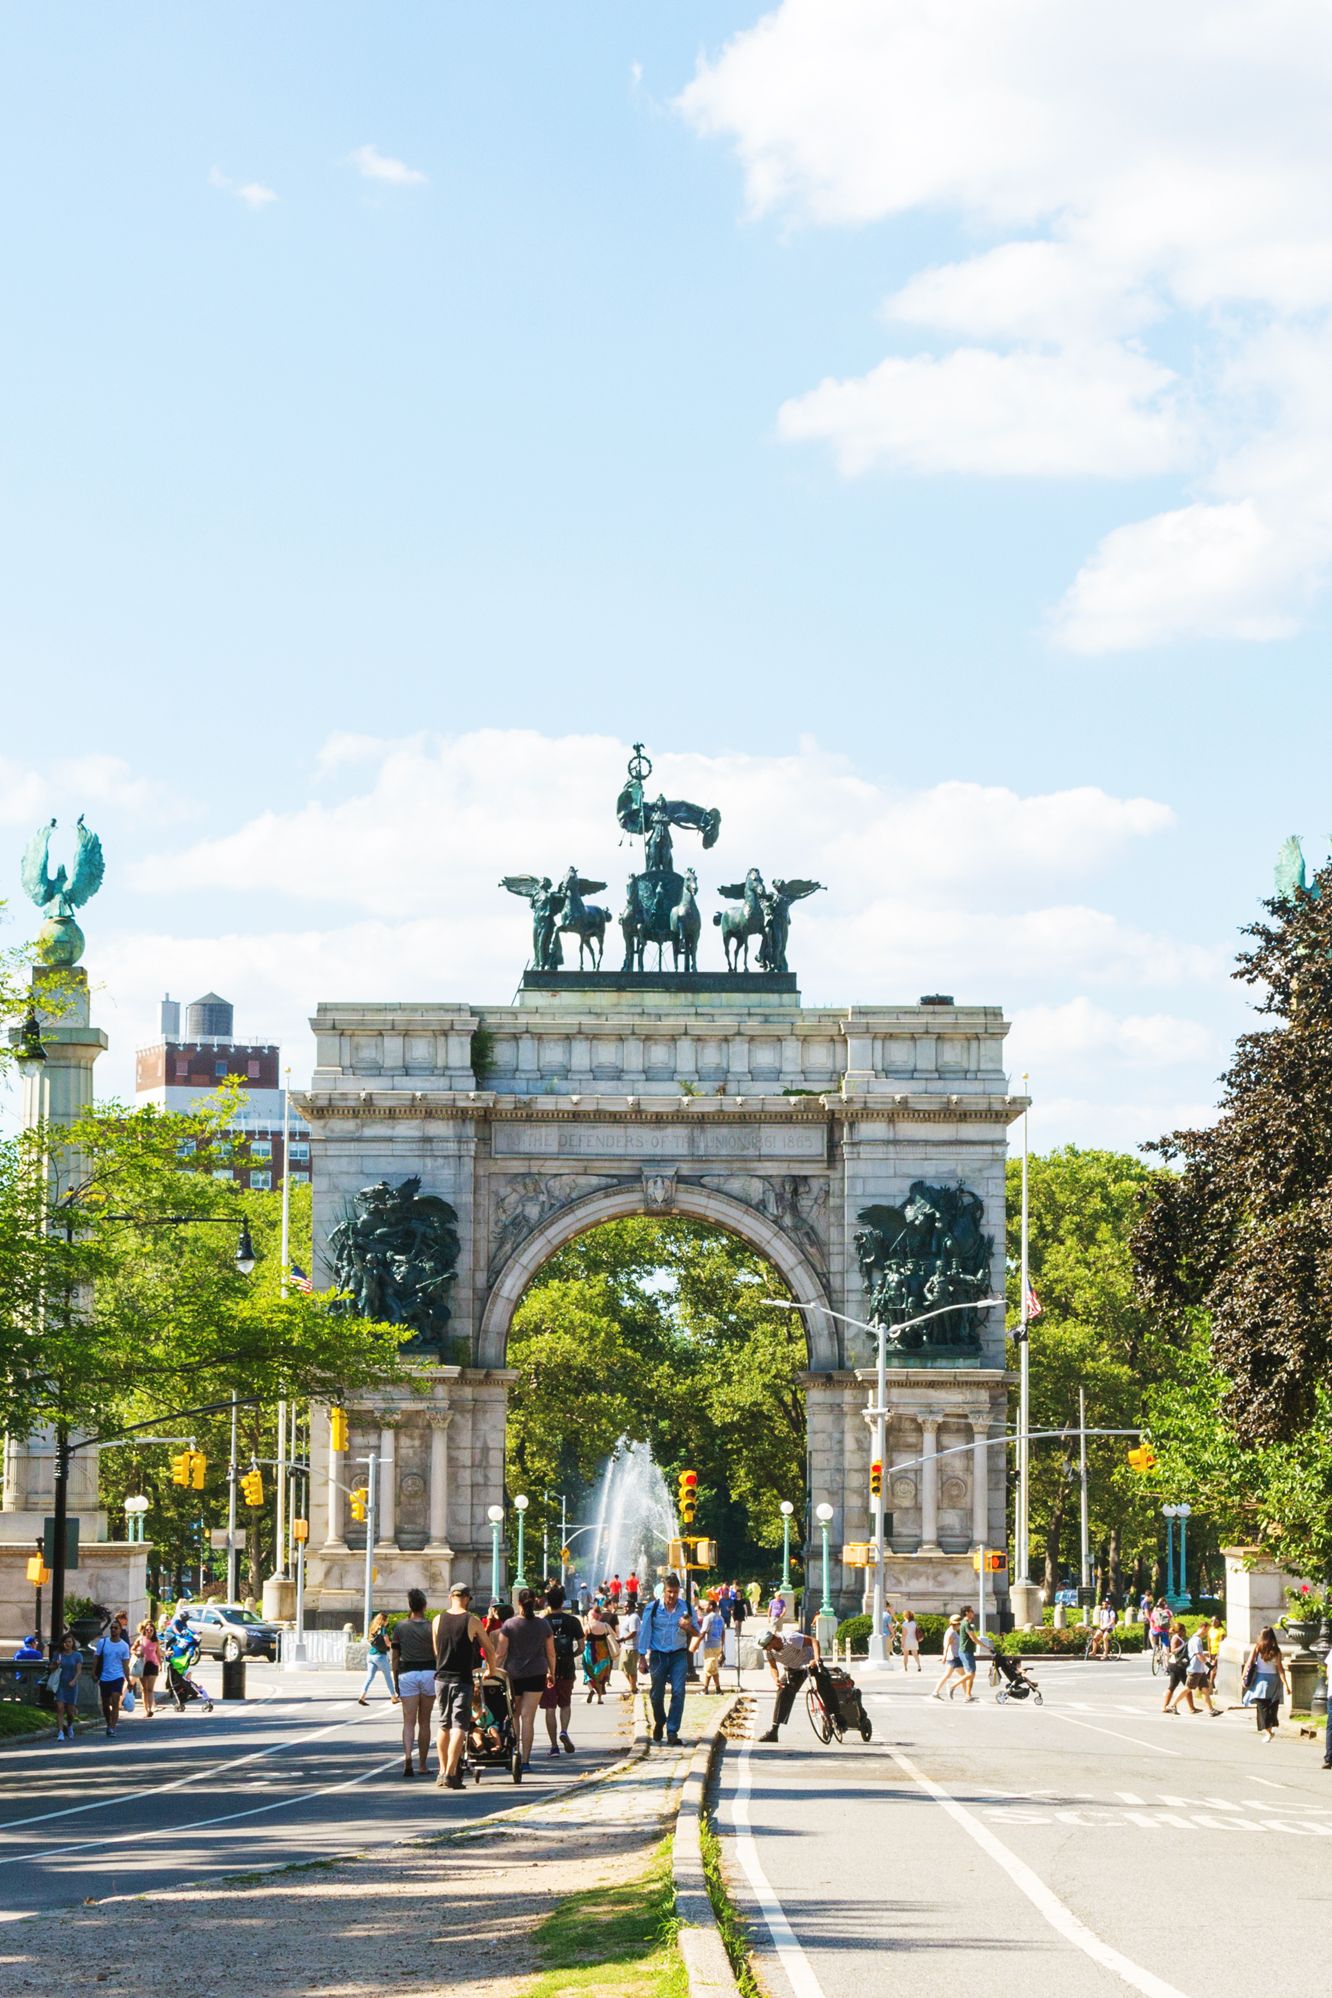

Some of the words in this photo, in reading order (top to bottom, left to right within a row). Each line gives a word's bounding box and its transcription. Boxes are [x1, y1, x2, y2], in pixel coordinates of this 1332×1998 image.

[527, 1134, 553, 1147] THE
[559, 1134, 644, 1148] DEFENDERS
[652, 1135, 669, 1148] OF
[673, 1135, 700, 1148] THE
[705, 1136, 747, 1149] UNION
[784, 1136, 813, 1149] 1865
[982, 1810, 1332, 1835] SCHOO
